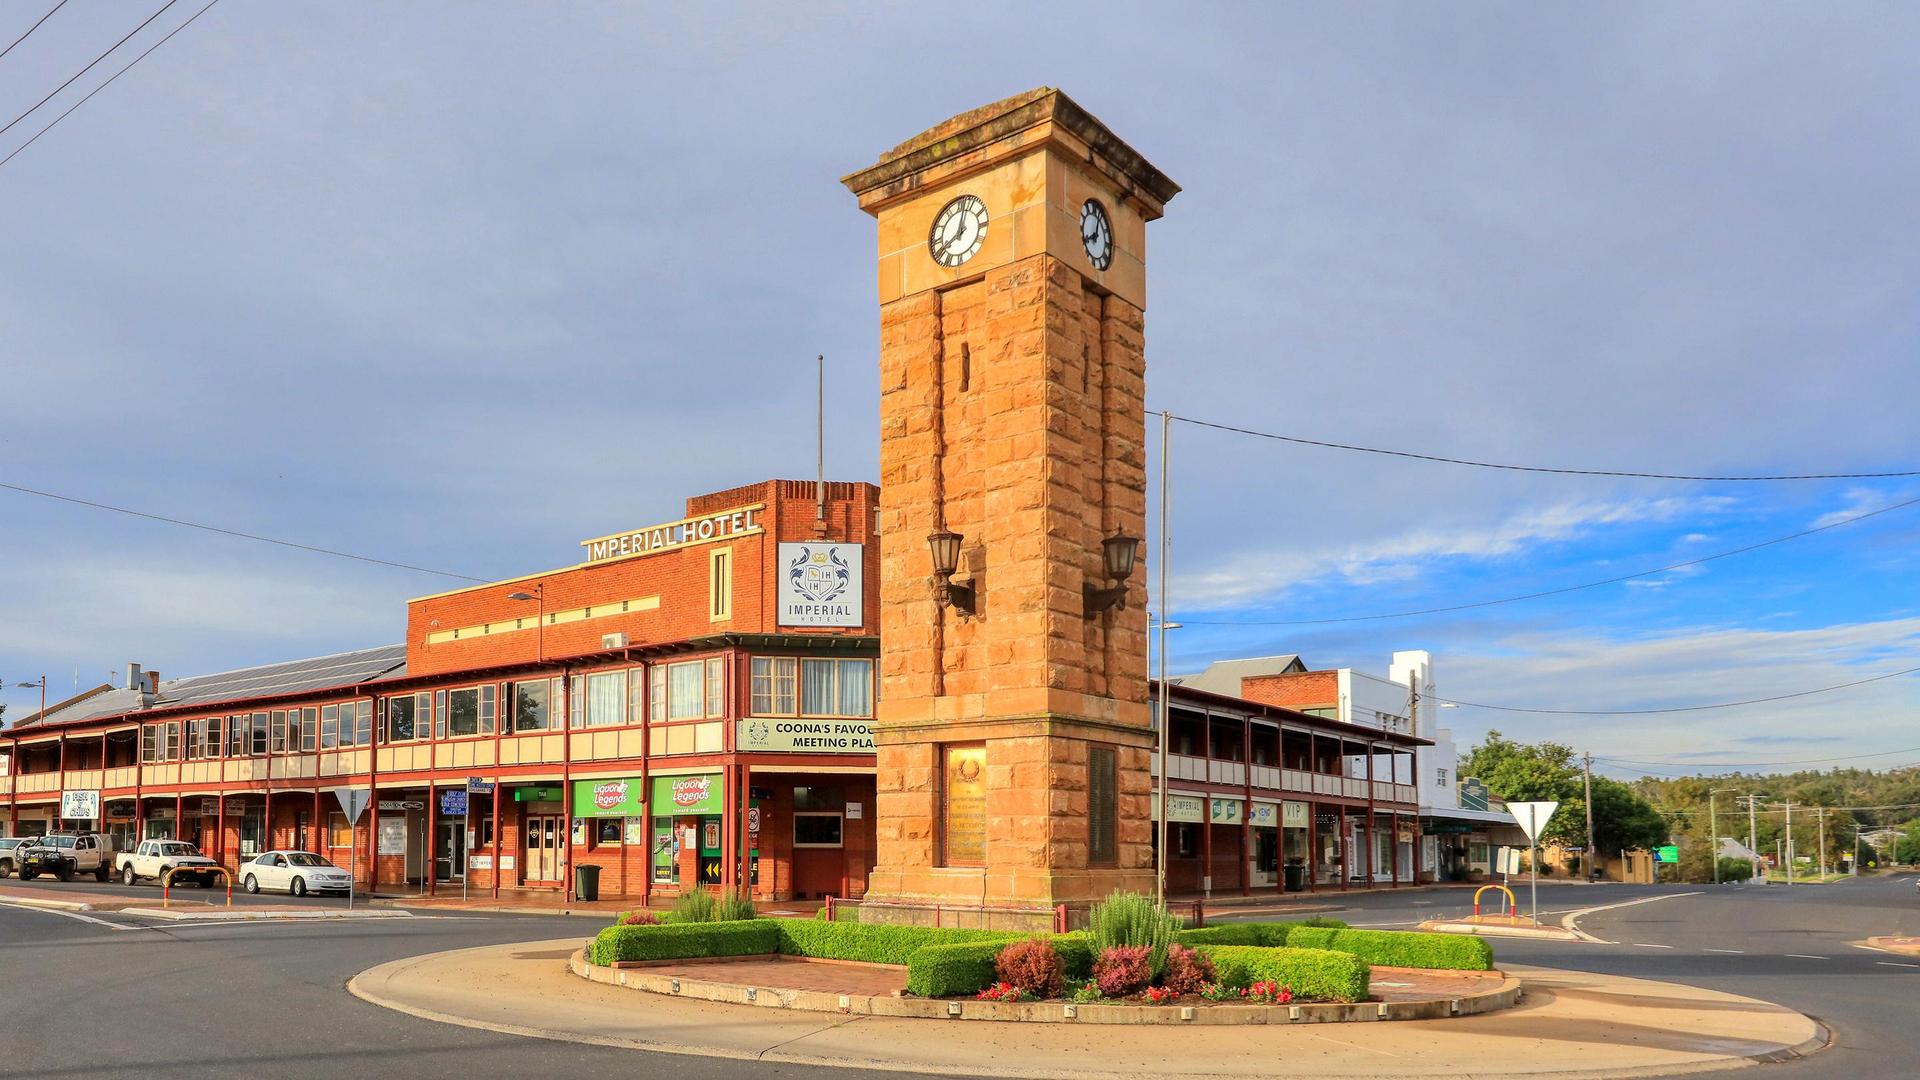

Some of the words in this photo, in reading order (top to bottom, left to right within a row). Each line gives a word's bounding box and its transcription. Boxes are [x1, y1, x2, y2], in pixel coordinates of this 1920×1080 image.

[587, 527, 677, 562] IMPERIAL
[682, 510, 759, 543] HOTEL
[821, 571, 831, 579] IH
[809, 583, 819, 591] IH
[789, 604, 851, 616] IMPERIAL
[776, 723, 831, 734] COONA'S
[792, 737, 848, 748] MEETING
[851, 738, 877, 748] PLA
[73, 792, 88, 801] FISH
[594, 793, 627, 805] Legends
[673, 789, 709, 802] Legends
[1176, 800, 1200, 811] IMPERIAL
[1286, 804, 1300, 818] VIP
[70, 808, 90, 816] CHIPS
